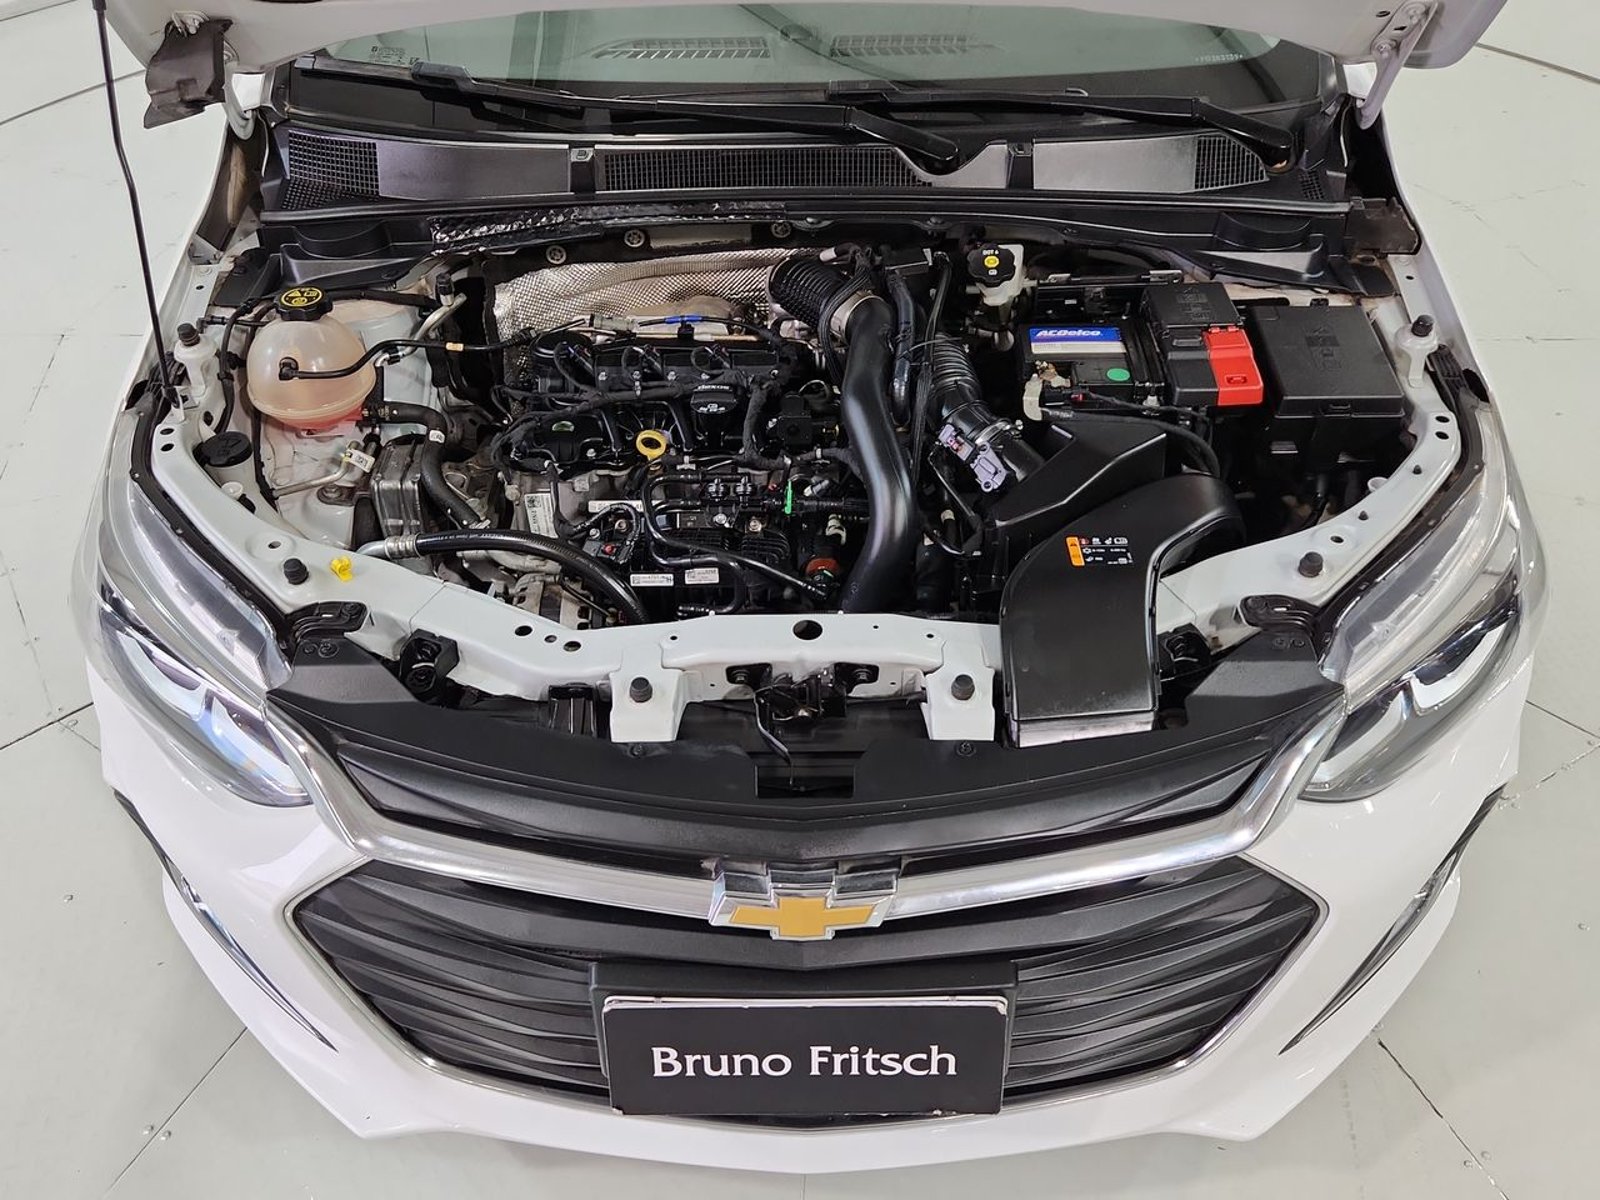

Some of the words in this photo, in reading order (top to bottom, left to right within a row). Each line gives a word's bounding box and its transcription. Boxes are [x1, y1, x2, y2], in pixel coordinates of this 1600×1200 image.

[1036, 329, 1101, 337] ACDelco
[651, 1046, 792, 1077] Bruno
[809, 1044, 957, 1076] Fritsch
